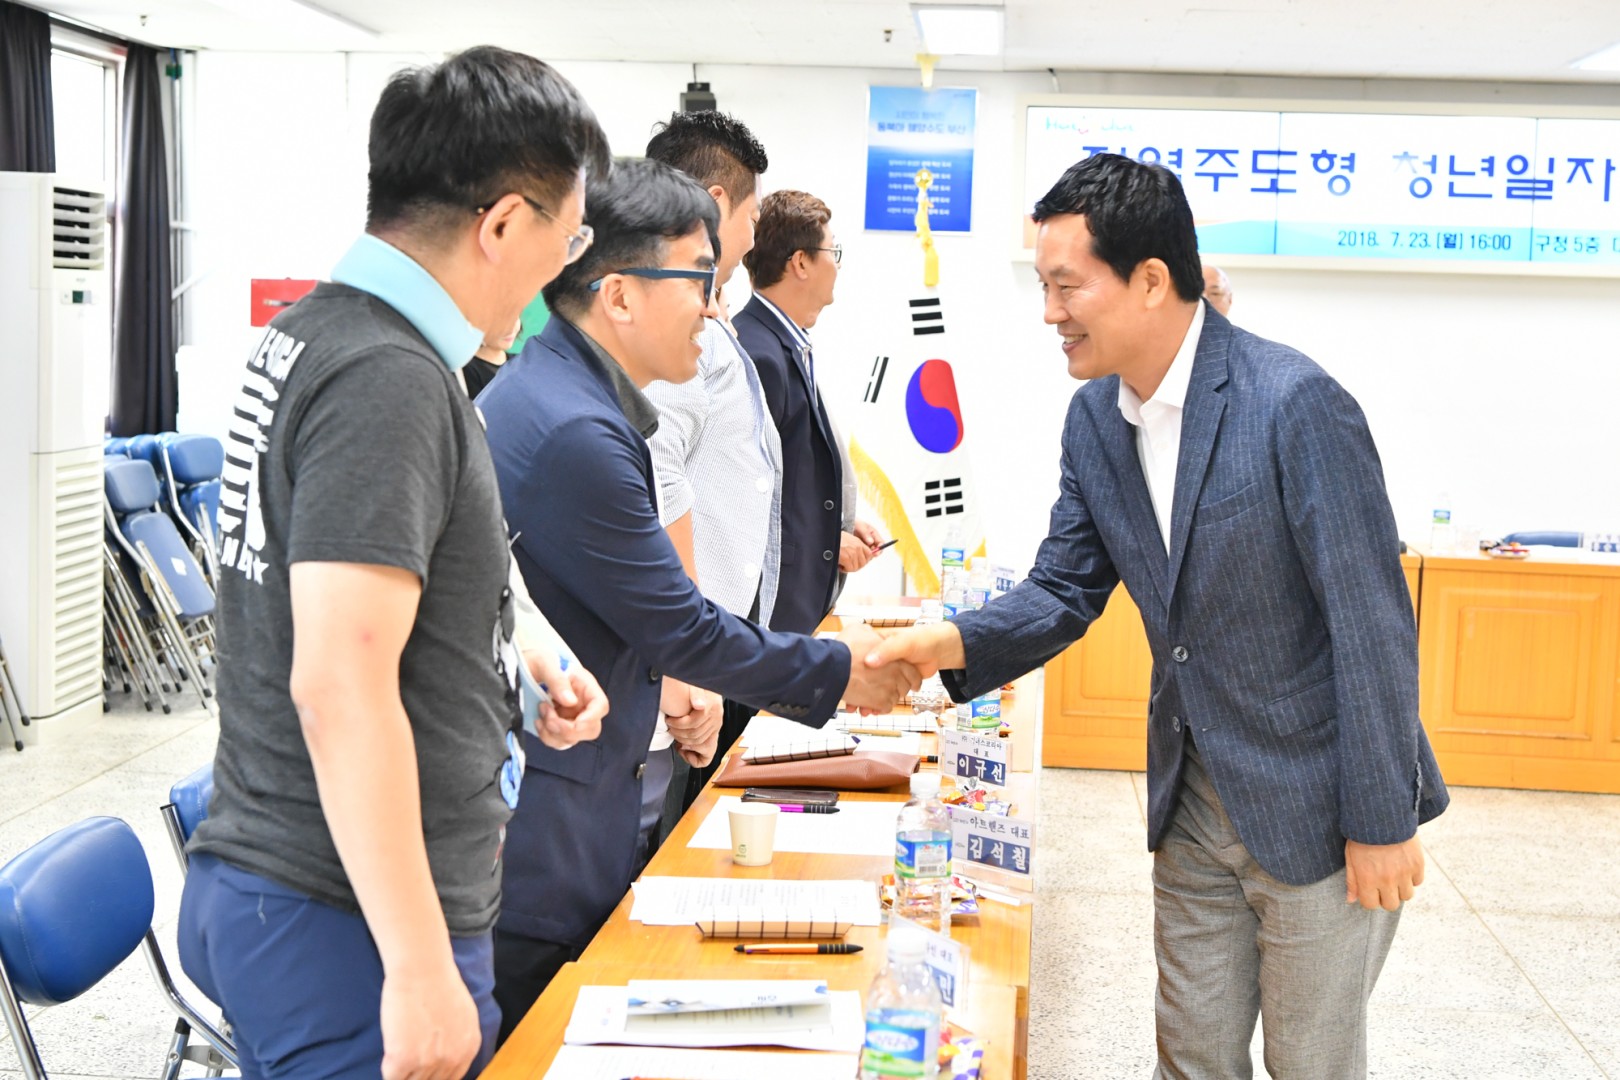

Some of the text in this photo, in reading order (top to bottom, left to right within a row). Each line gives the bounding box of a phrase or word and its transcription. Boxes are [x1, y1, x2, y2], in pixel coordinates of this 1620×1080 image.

[1082, 146, 1356, 197] 역주도형
[1337, 230, 1379, 246] 2018.
[1470, 234, 1511, 250] 16:00
[1536, 235, 1568, 253] 구청
[1574, 236, 1600, 254] 5층
[1011, 826, 1030, 839] 대표
